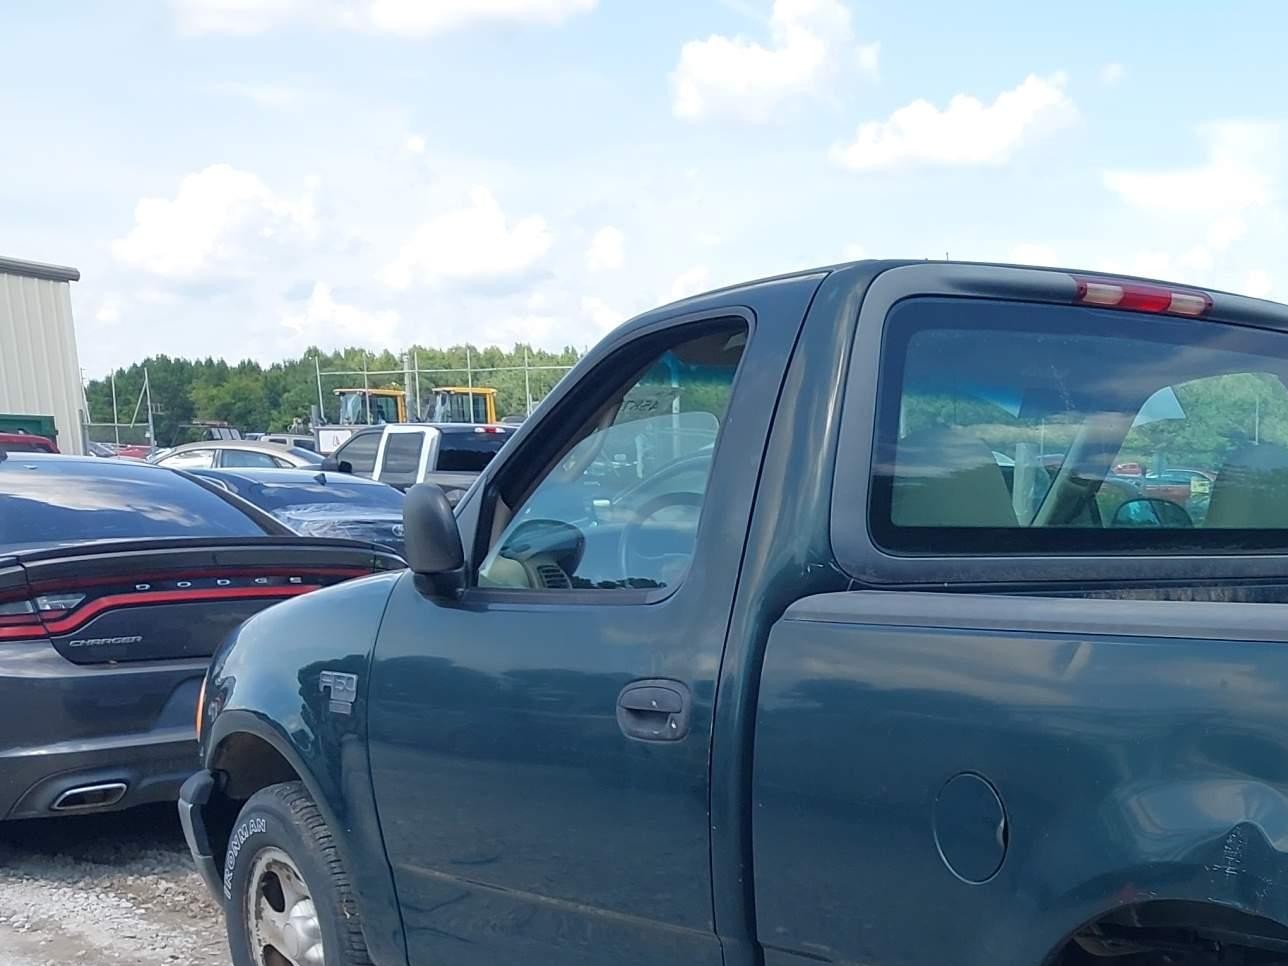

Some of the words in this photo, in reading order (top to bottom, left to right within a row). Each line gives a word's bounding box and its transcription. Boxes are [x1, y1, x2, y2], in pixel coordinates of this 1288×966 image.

[135, 576, 303, 591] DODGE
[69, 635, 143, 648] CHARGER
[223, 817, 267, 900] IRONMAN
